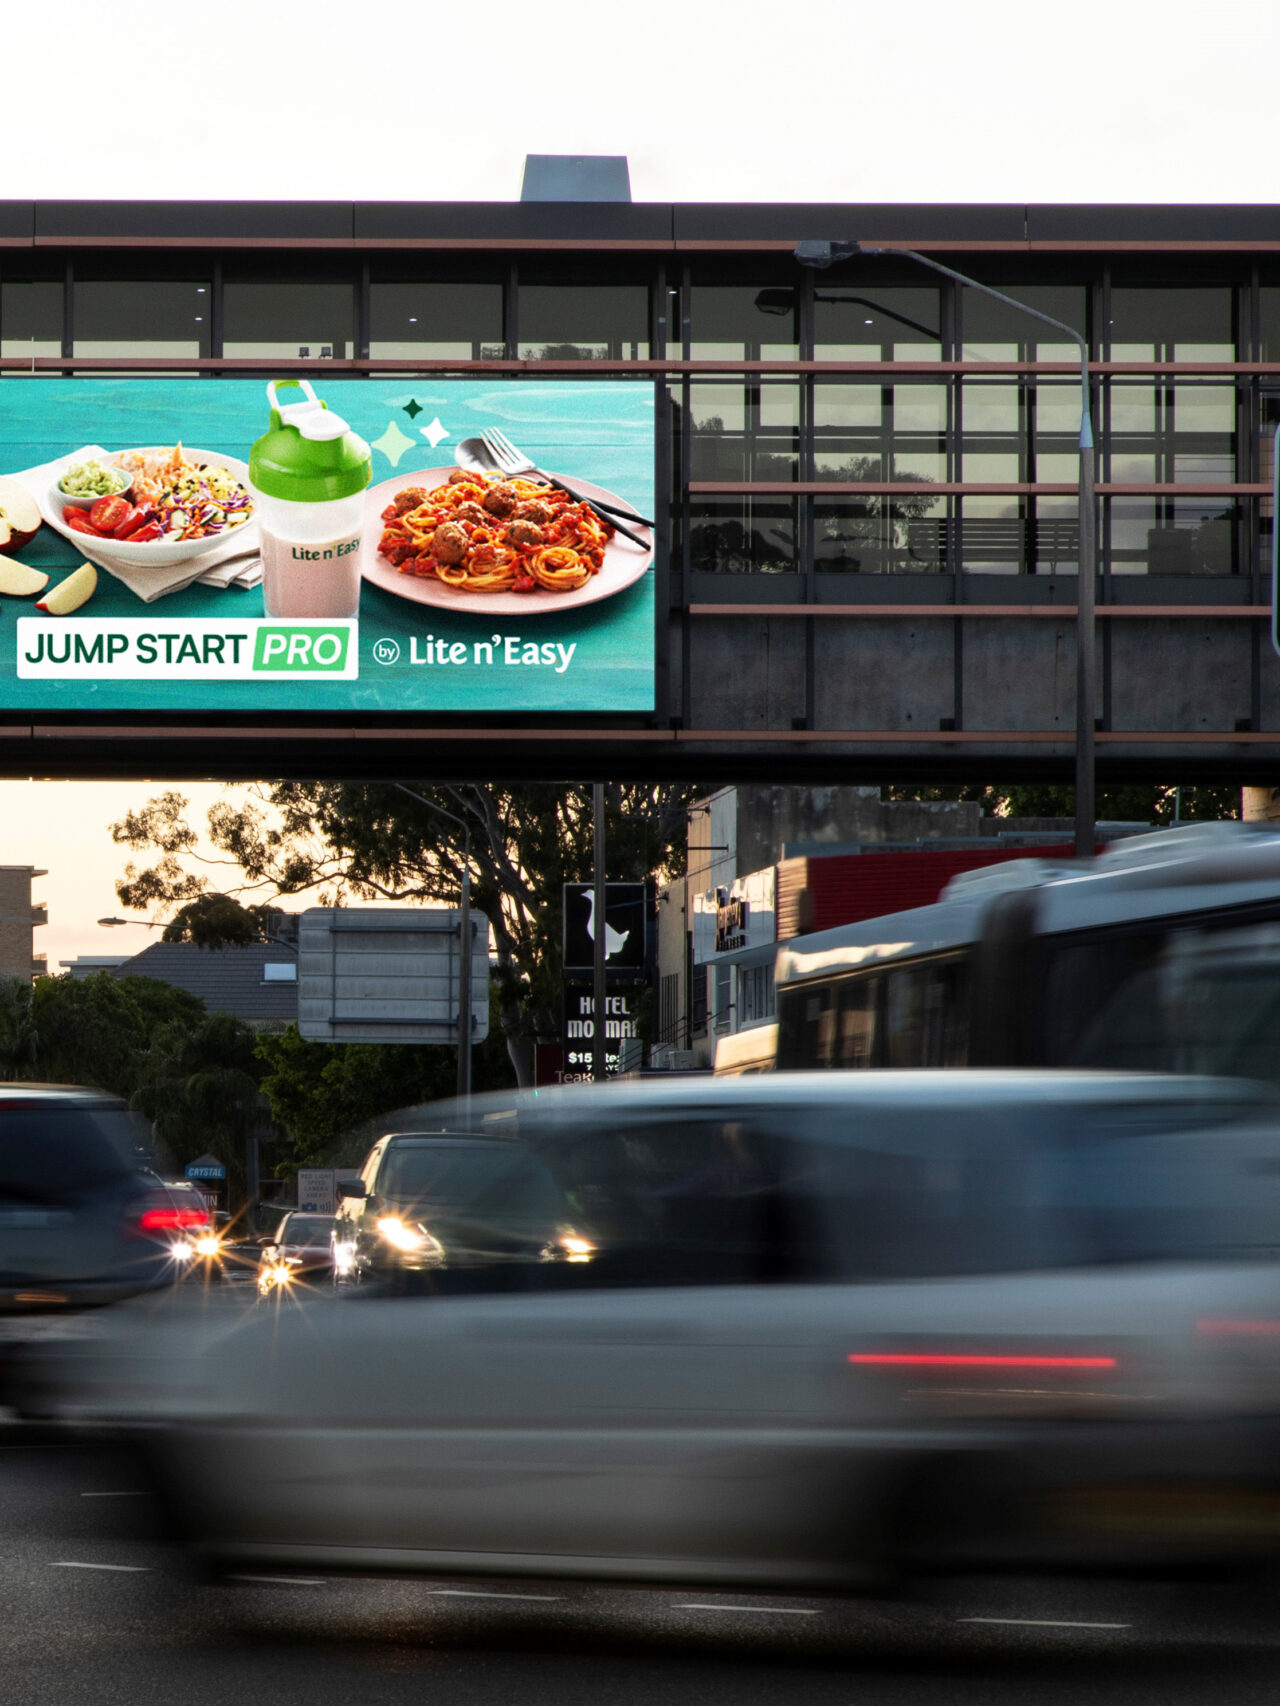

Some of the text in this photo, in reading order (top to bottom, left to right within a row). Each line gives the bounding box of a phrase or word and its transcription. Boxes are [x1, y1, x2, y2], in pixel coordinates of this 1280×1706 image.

[292, 547, 320, 560] Lite
[25, 633, 341, 665] JUMP START PRO
[378, 644, 395, 660] by
[410, 636, 467, 665] Lite
[188, 1167, 223, 1177] CRYSTAL
